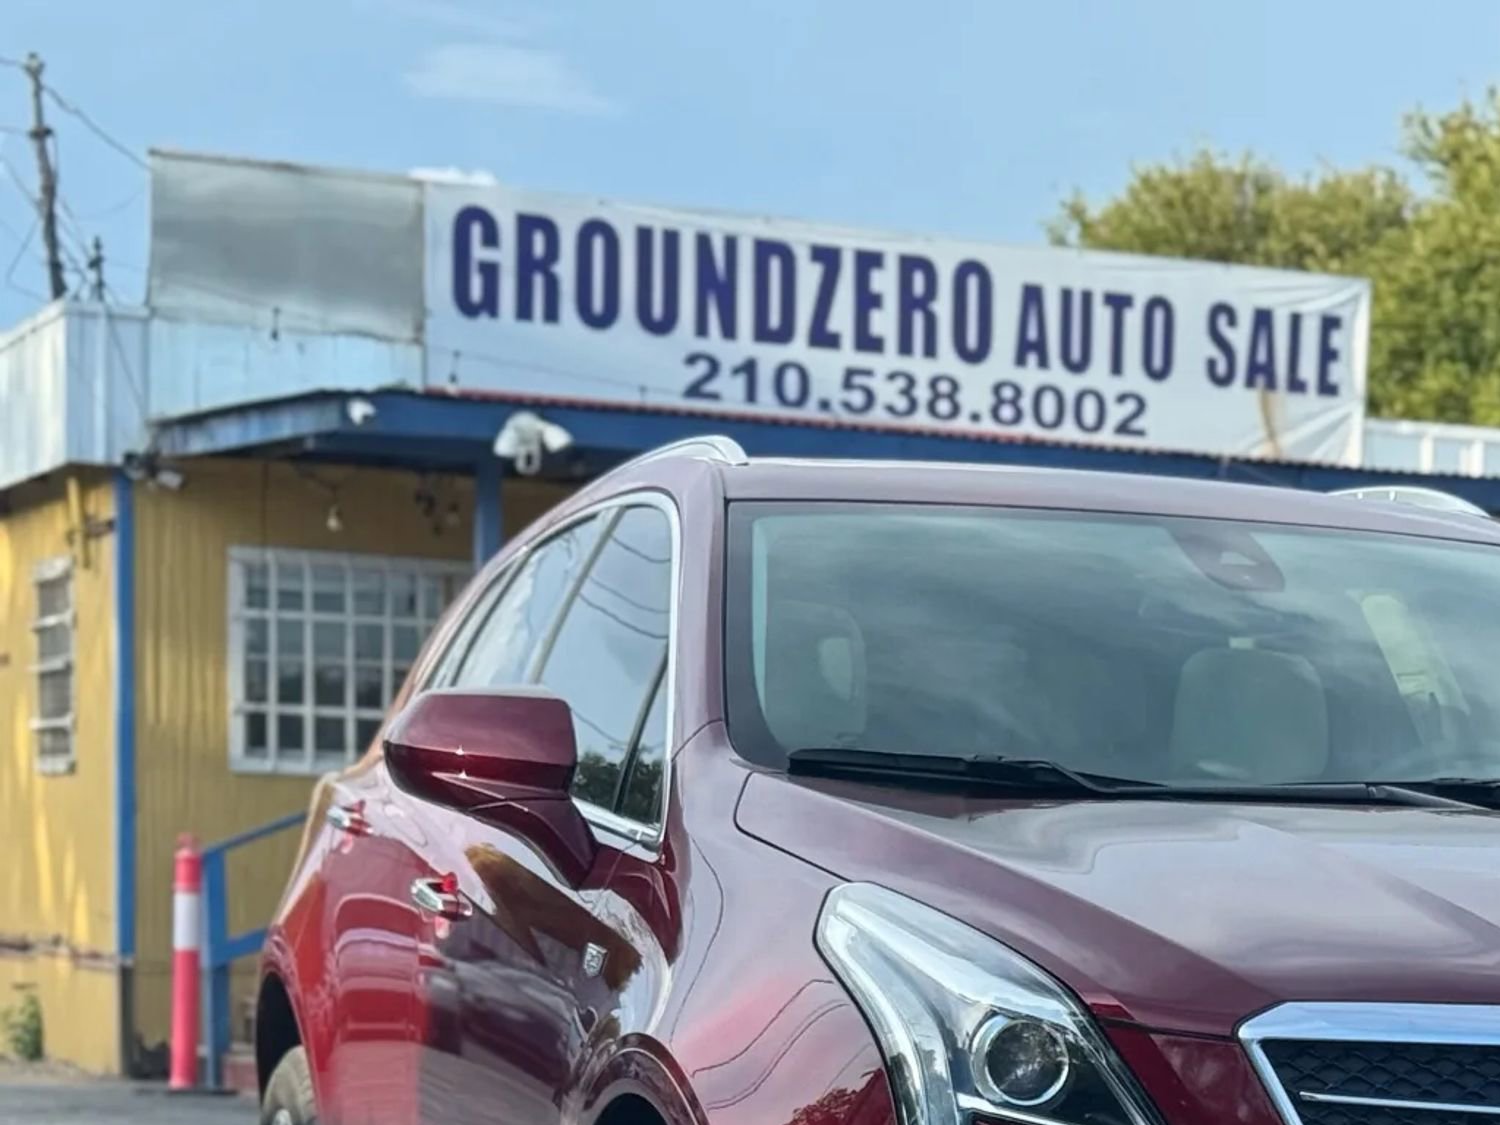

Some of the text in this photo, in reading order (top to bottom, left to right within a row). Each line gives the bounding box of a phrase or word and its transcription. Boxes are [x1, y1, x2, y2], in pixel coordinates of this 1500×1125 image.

[452, 205, 1343, 397] GROUNDZERO AUTO SALE
[682, 352, 1148, 437] 210.538.8002
